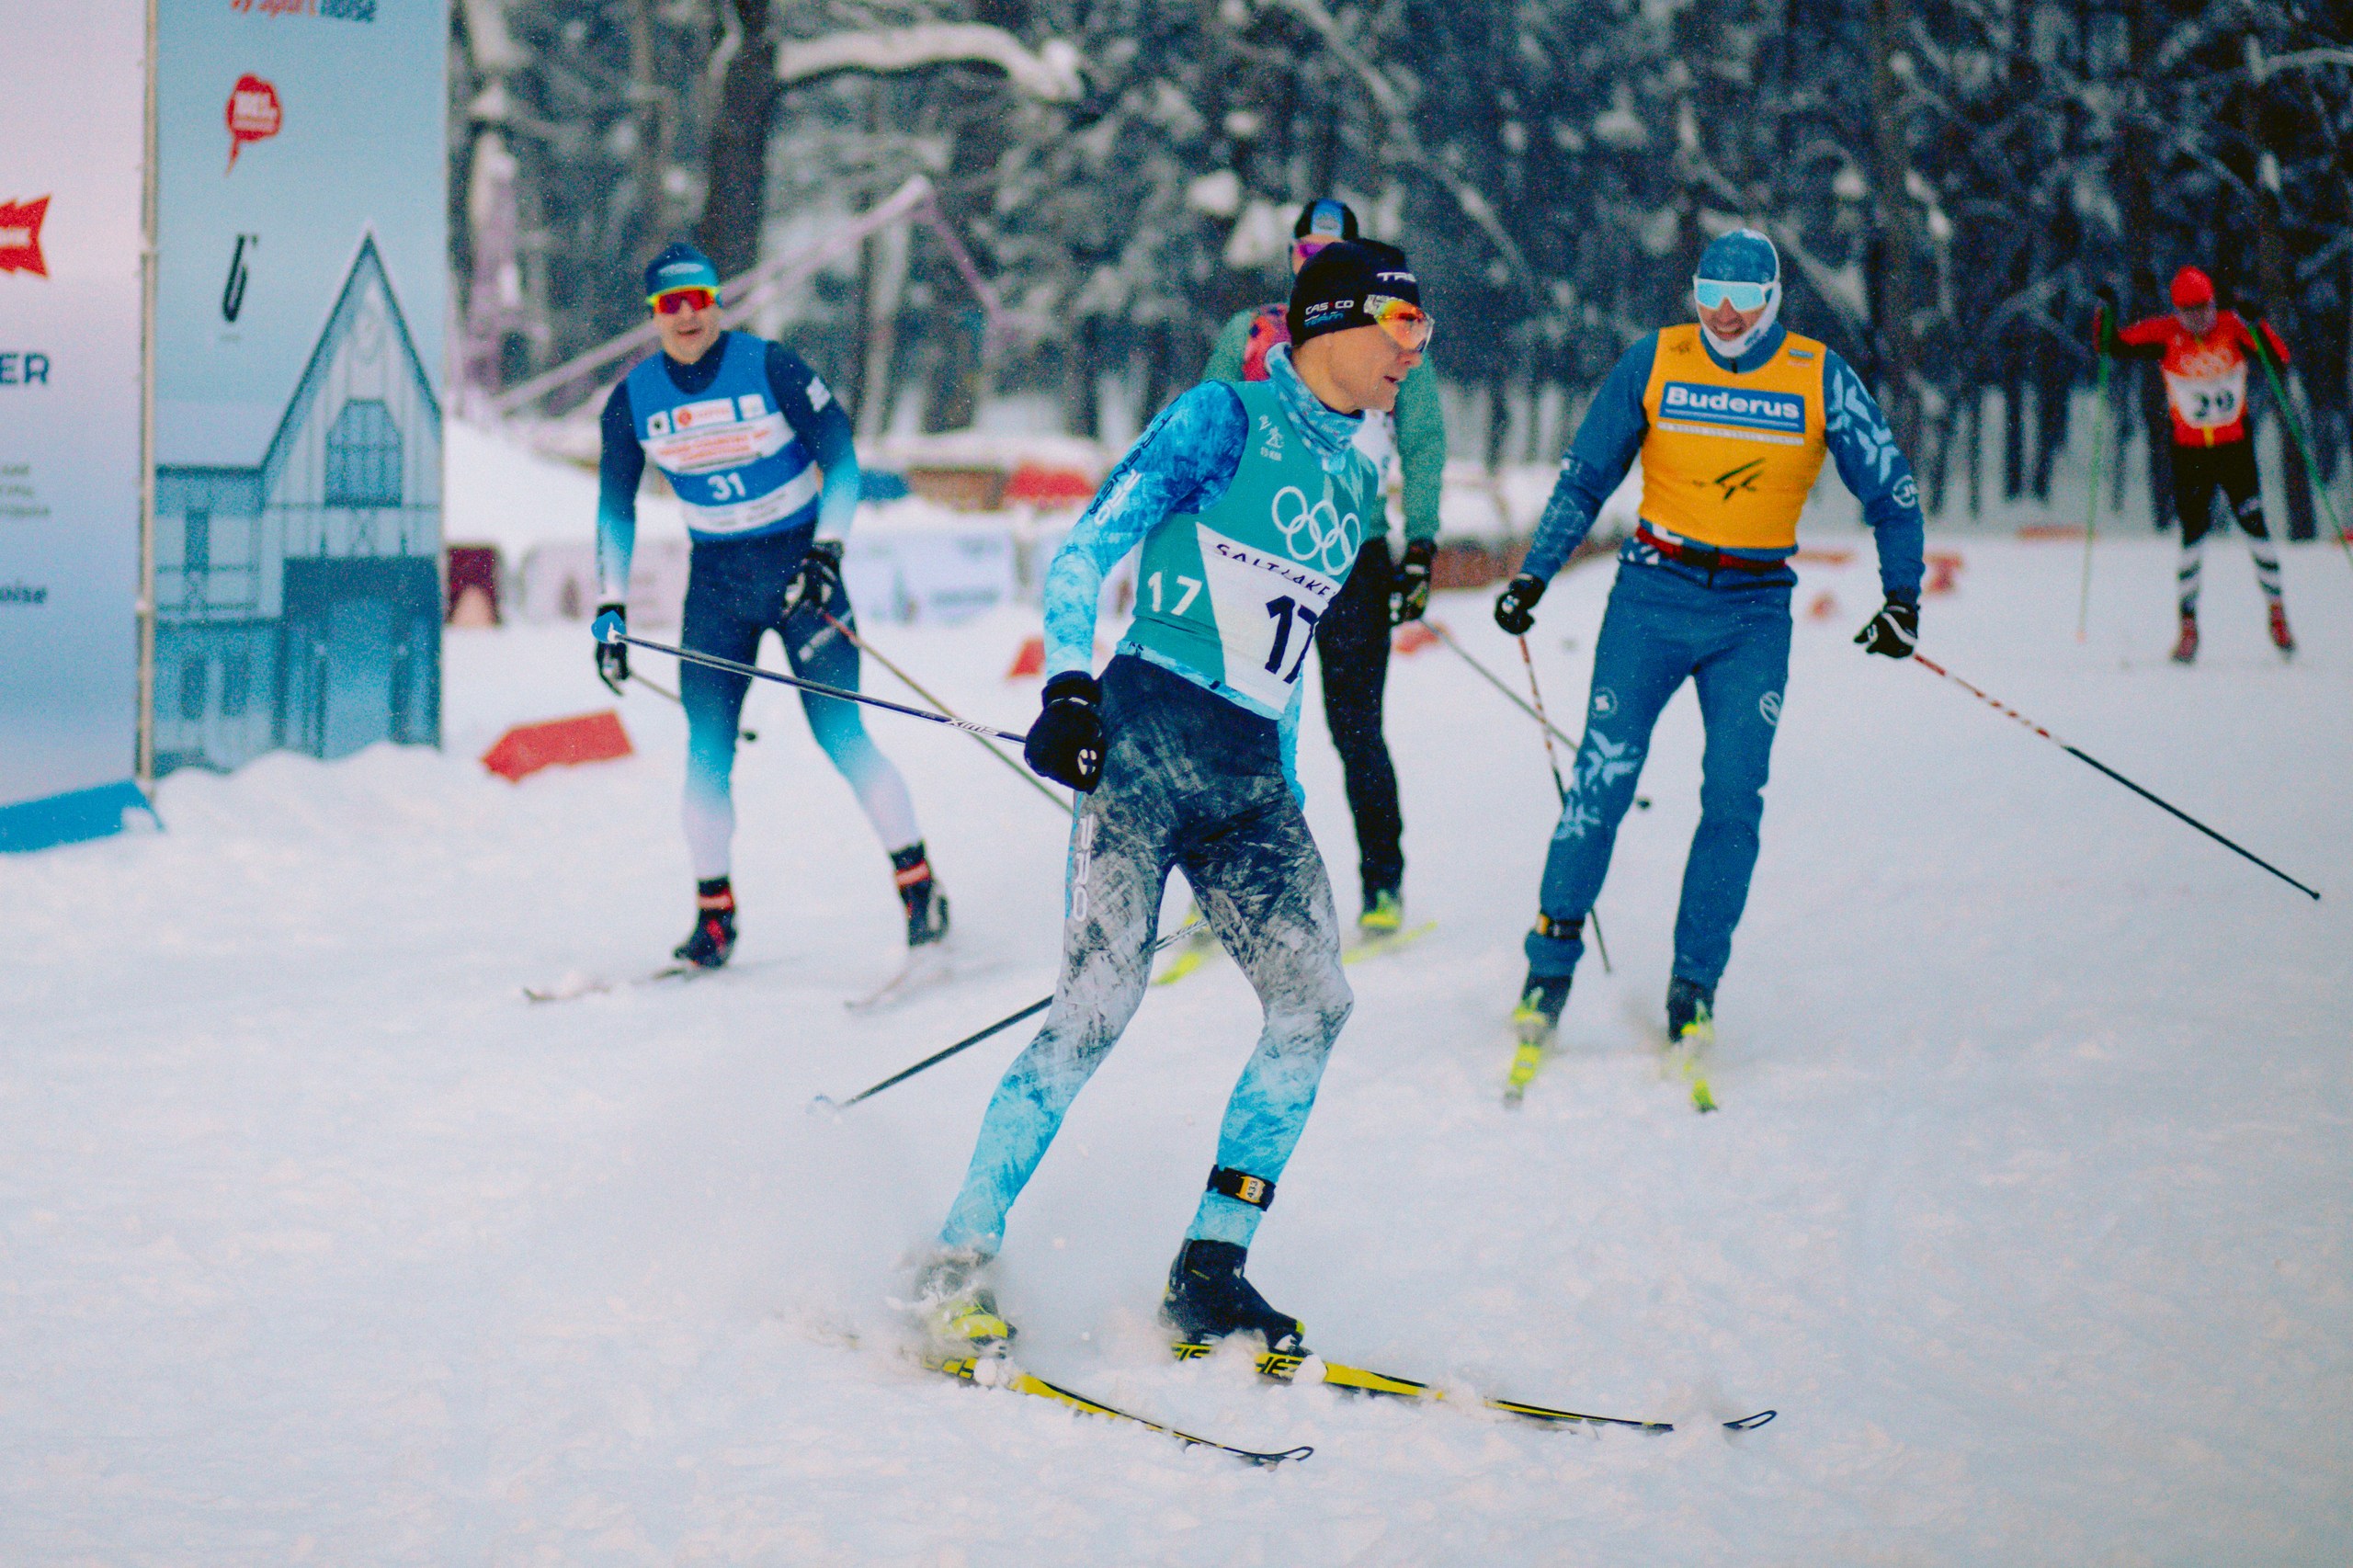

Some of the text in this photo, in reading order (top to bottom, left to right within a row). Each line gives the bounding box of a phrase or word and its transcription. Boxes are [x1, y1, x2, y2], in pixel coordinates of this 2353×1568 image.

[0, 352, 50, 384] ER
[1665, 385, 1801, 419] Buderus
[707, 472, 746, 501] 31
[1147, 571, 1203, 617] 17
[1264, 594, 1320, 686] 17
[1072, 813, 1095, 923] PRO
